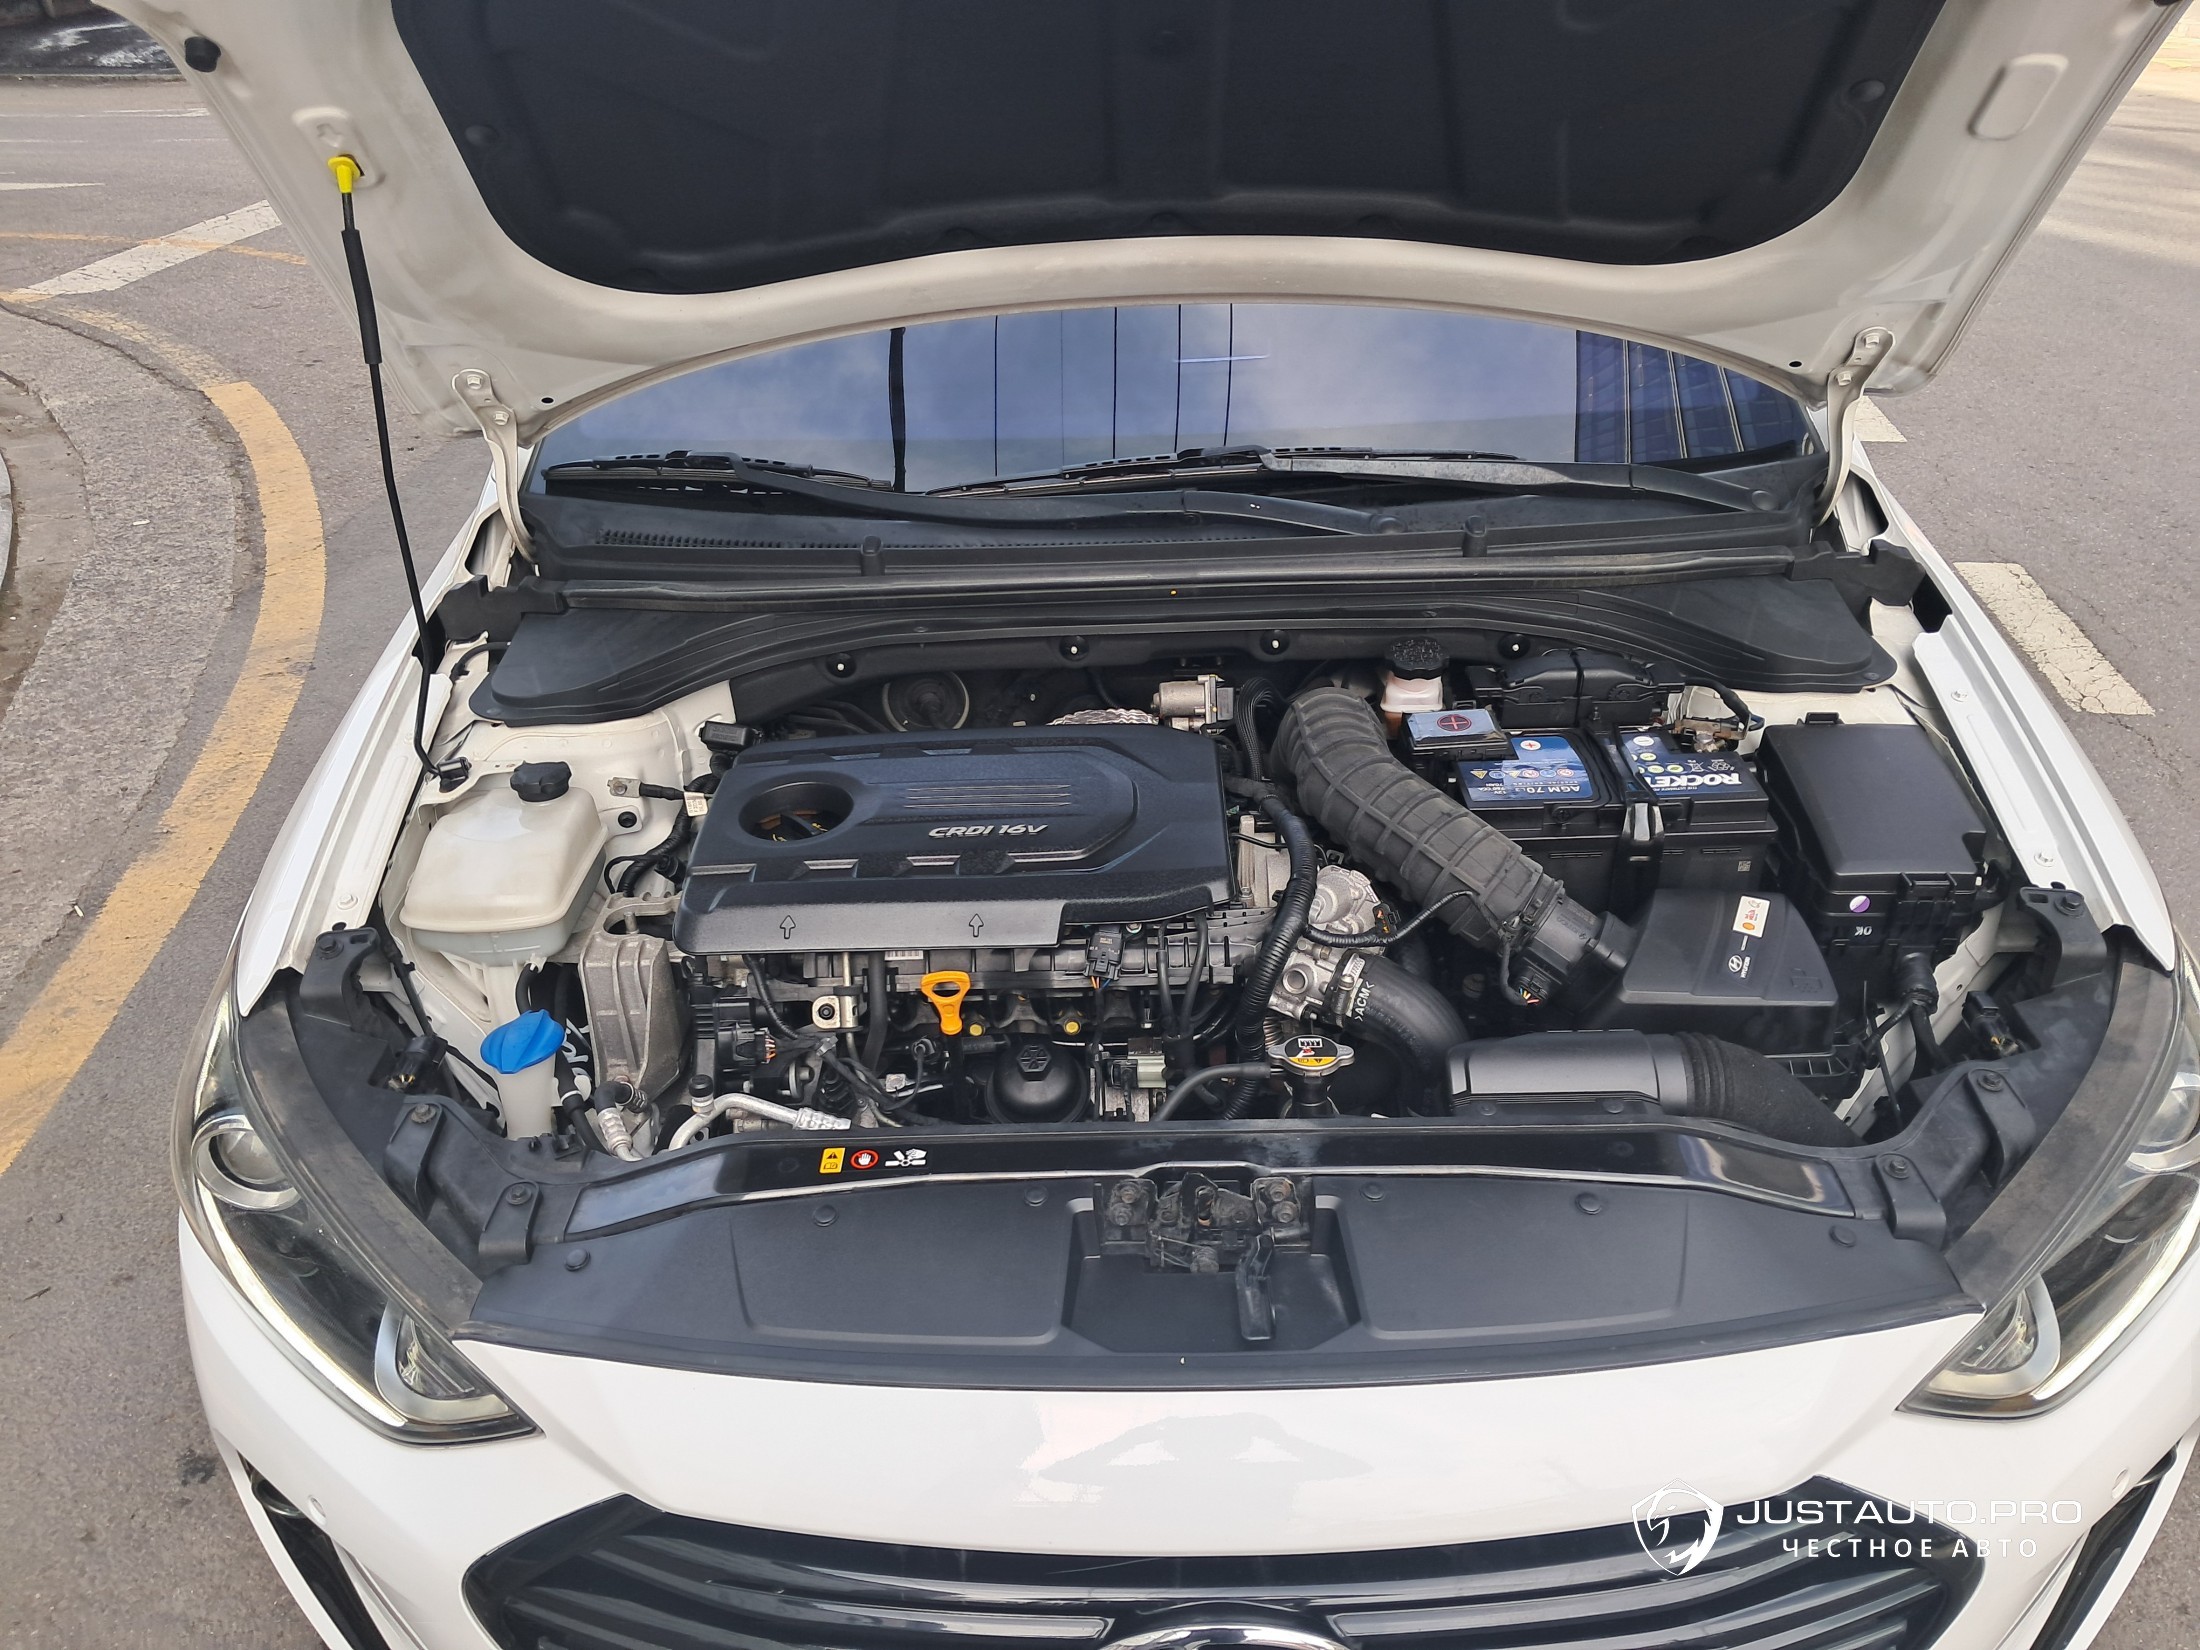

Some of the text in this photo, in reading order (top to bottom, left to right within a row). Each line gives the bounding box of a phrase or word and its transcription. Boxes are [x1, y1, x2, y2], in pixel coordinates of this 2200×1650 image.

[1547, 785, 1581, 794] AGM
[928, 824, 1049, 838] CRDI 16V
[1854, 925, 1873, 937] OK
